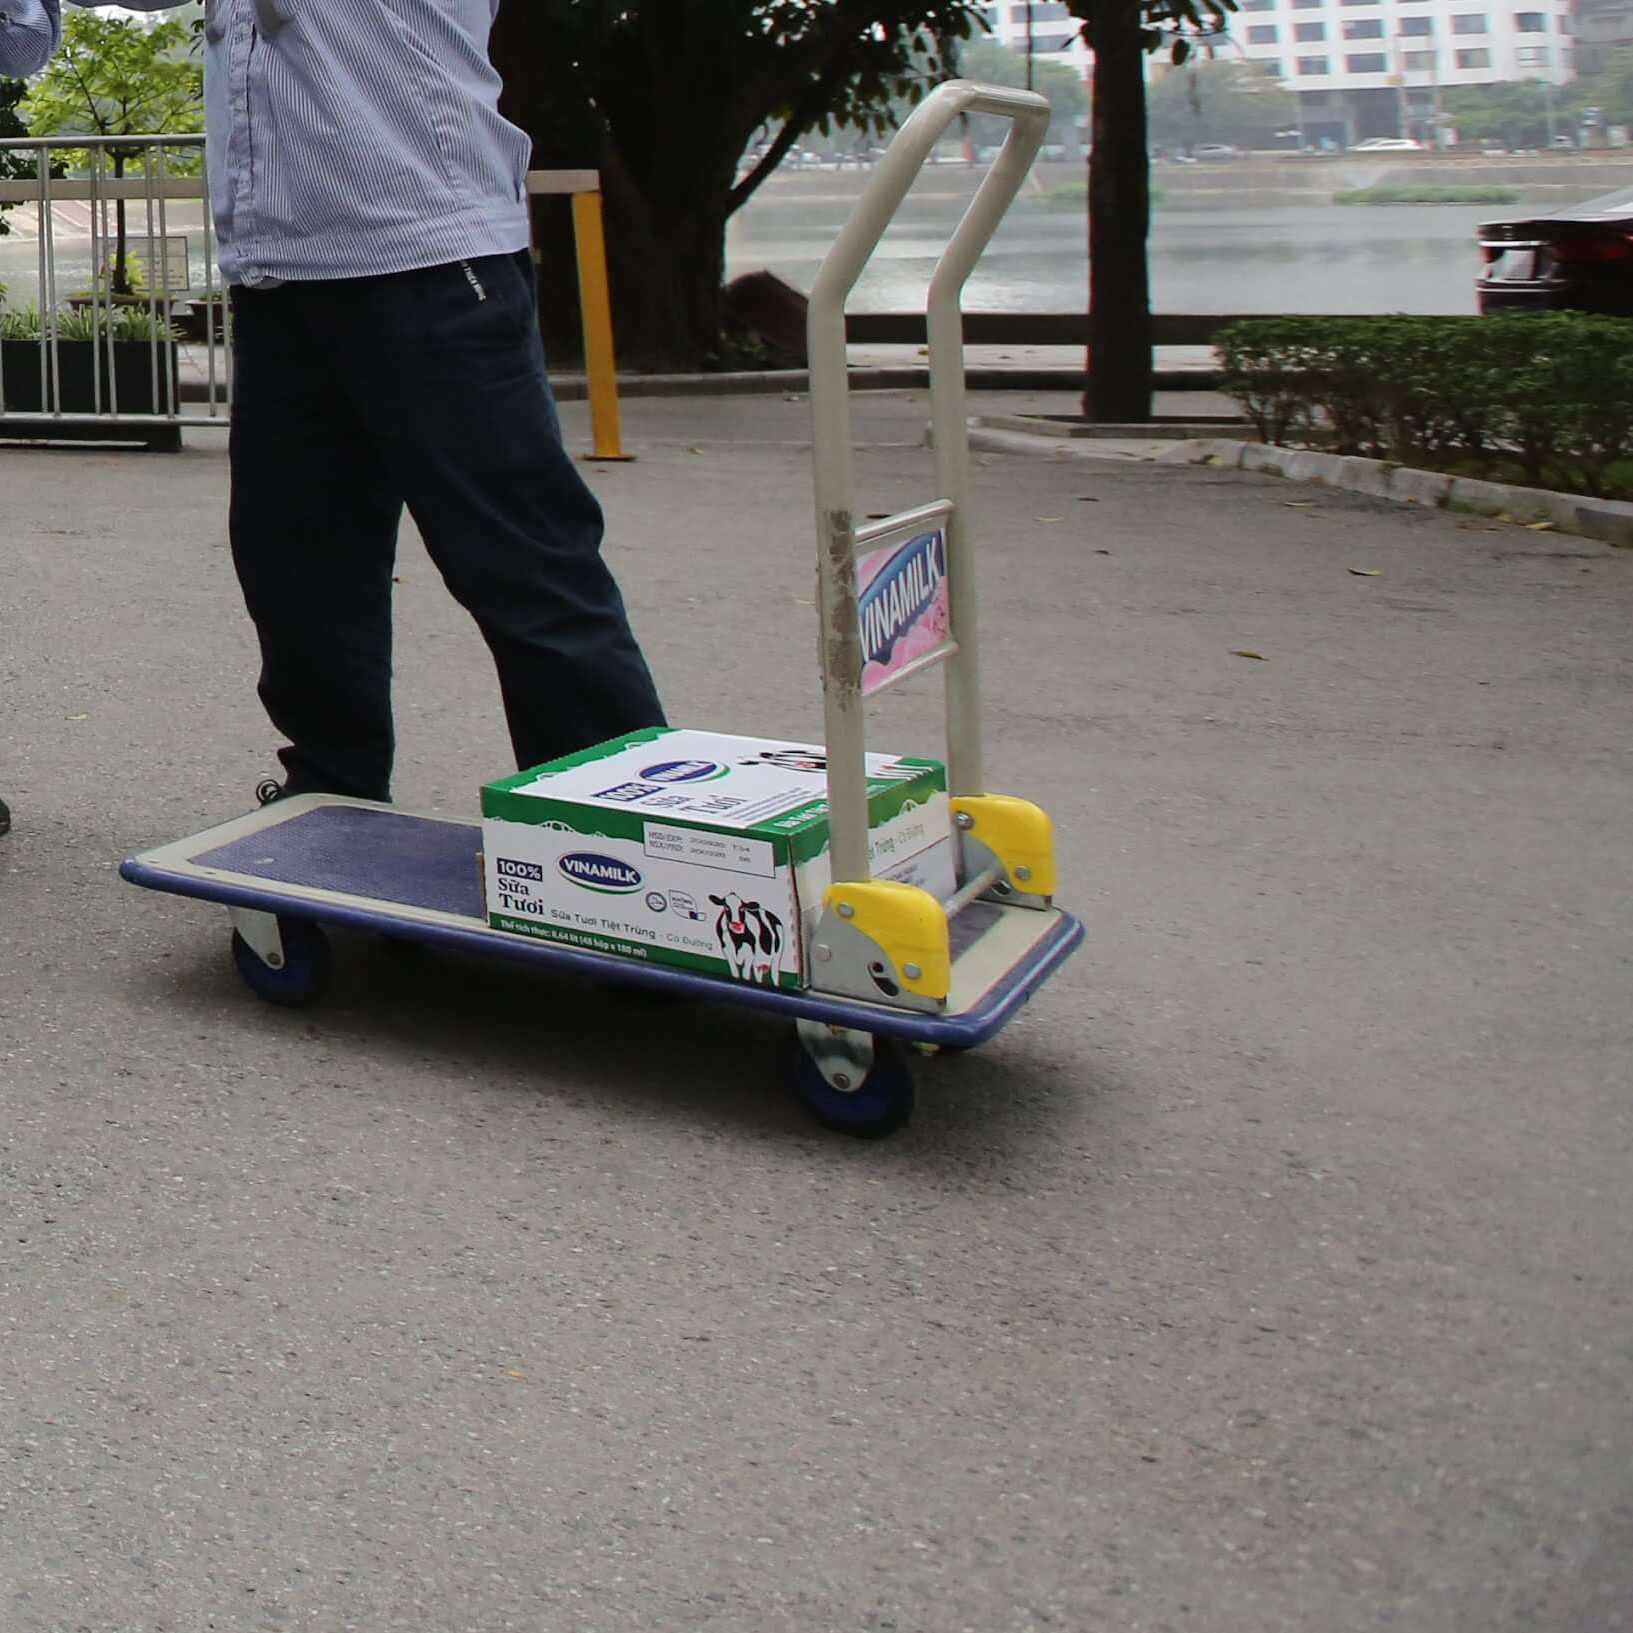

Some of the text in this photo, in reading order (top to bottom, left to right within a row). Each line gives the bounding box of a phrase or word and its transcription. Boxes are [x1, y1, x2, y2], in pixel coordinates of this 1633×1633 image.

[859, 537, 940, 662] VINAMILK
[499, 860, 542, 880] 100%
[563, 858, 637, 884] VINAMILK
[498, 877, 530, 896] Sữa
[499, 893, 544, 915] Tươi
